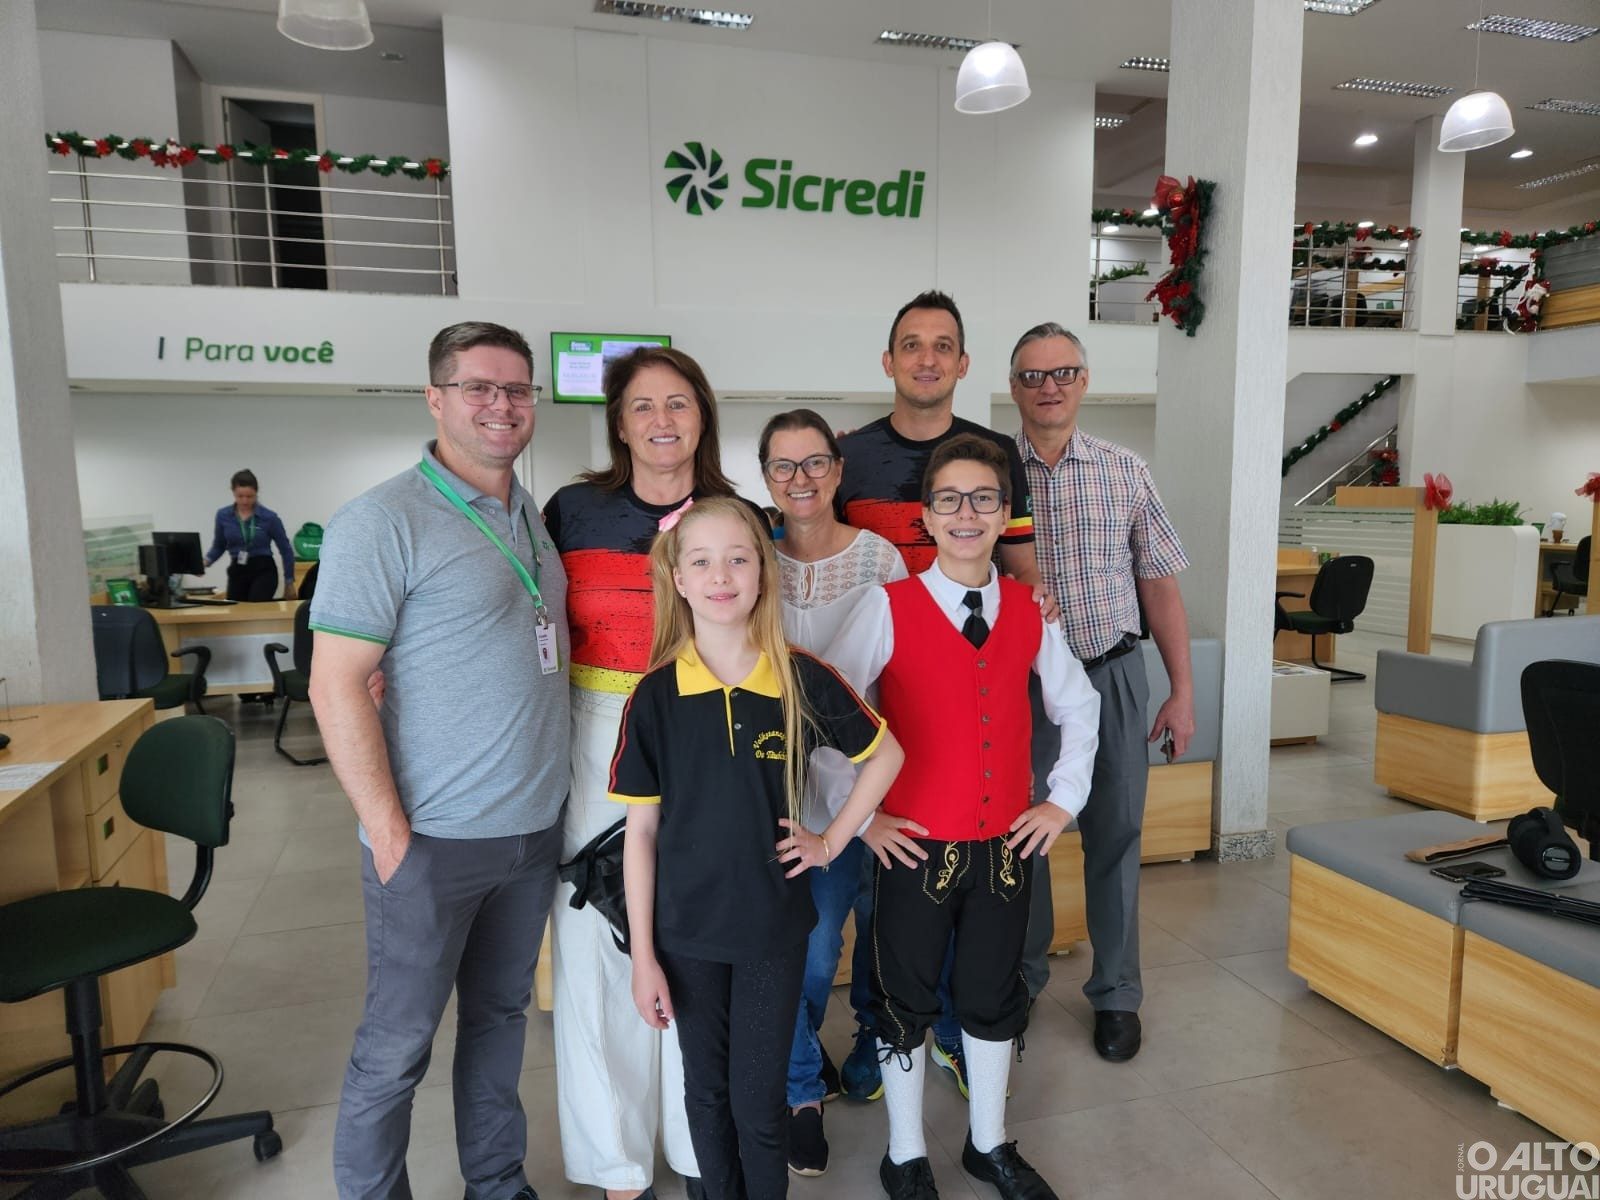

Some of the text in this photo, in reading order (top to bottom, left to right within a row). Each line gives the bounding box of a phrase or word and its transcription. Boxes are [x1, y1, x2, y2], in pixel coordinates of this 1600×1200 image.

[741, 157, 926, 219] Sicredi
[185, 336, 335, 364] Para você
